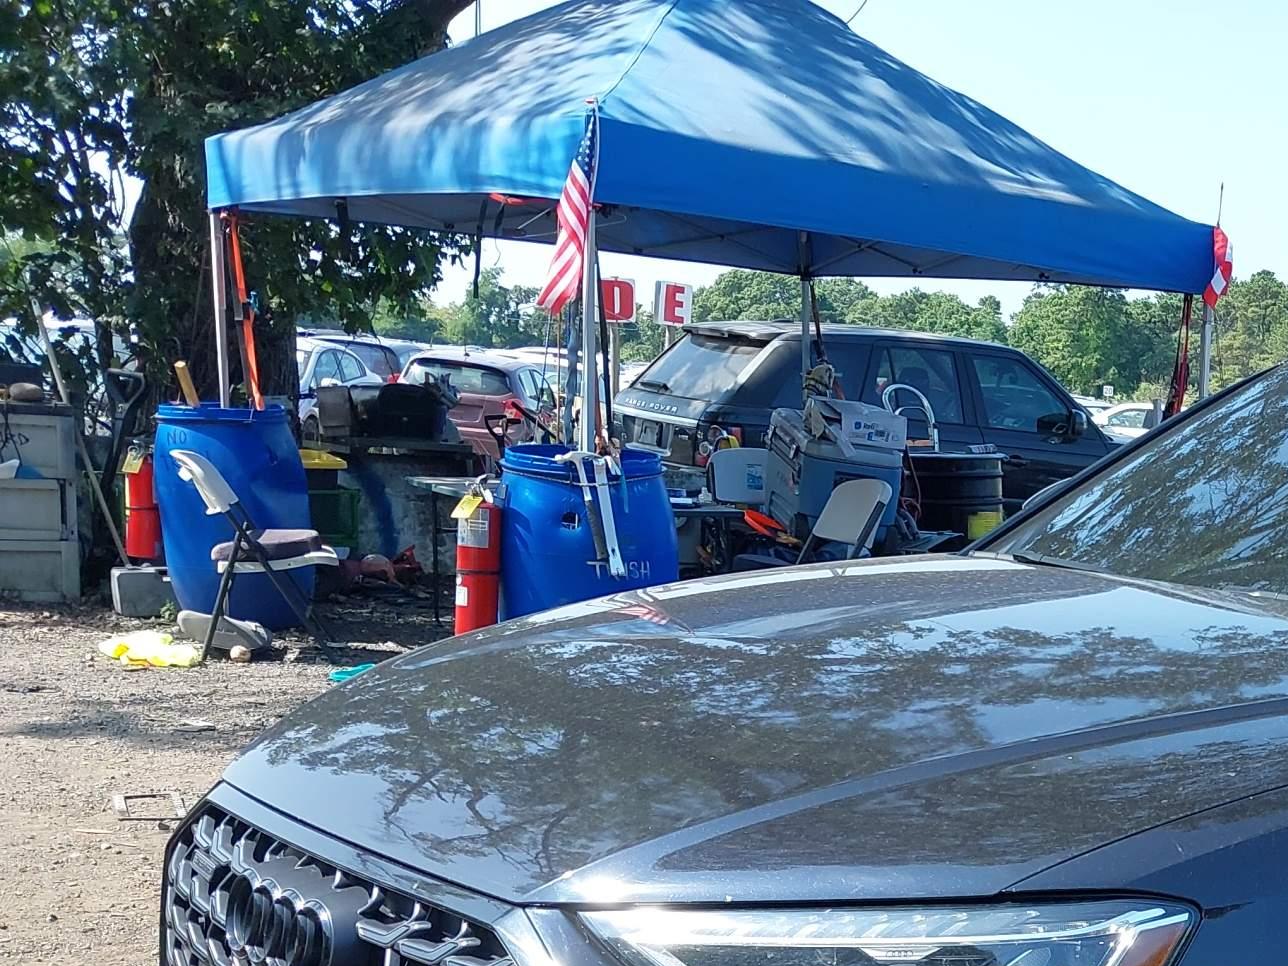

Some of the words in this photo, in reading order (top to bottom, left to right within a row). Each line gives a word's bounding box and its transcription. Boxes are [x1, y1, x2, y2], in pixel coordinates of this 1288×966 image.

[601, 280, 635, 321] D
[663, 284, 685, 324] E
[648, 402, 678, 414] ROVER
